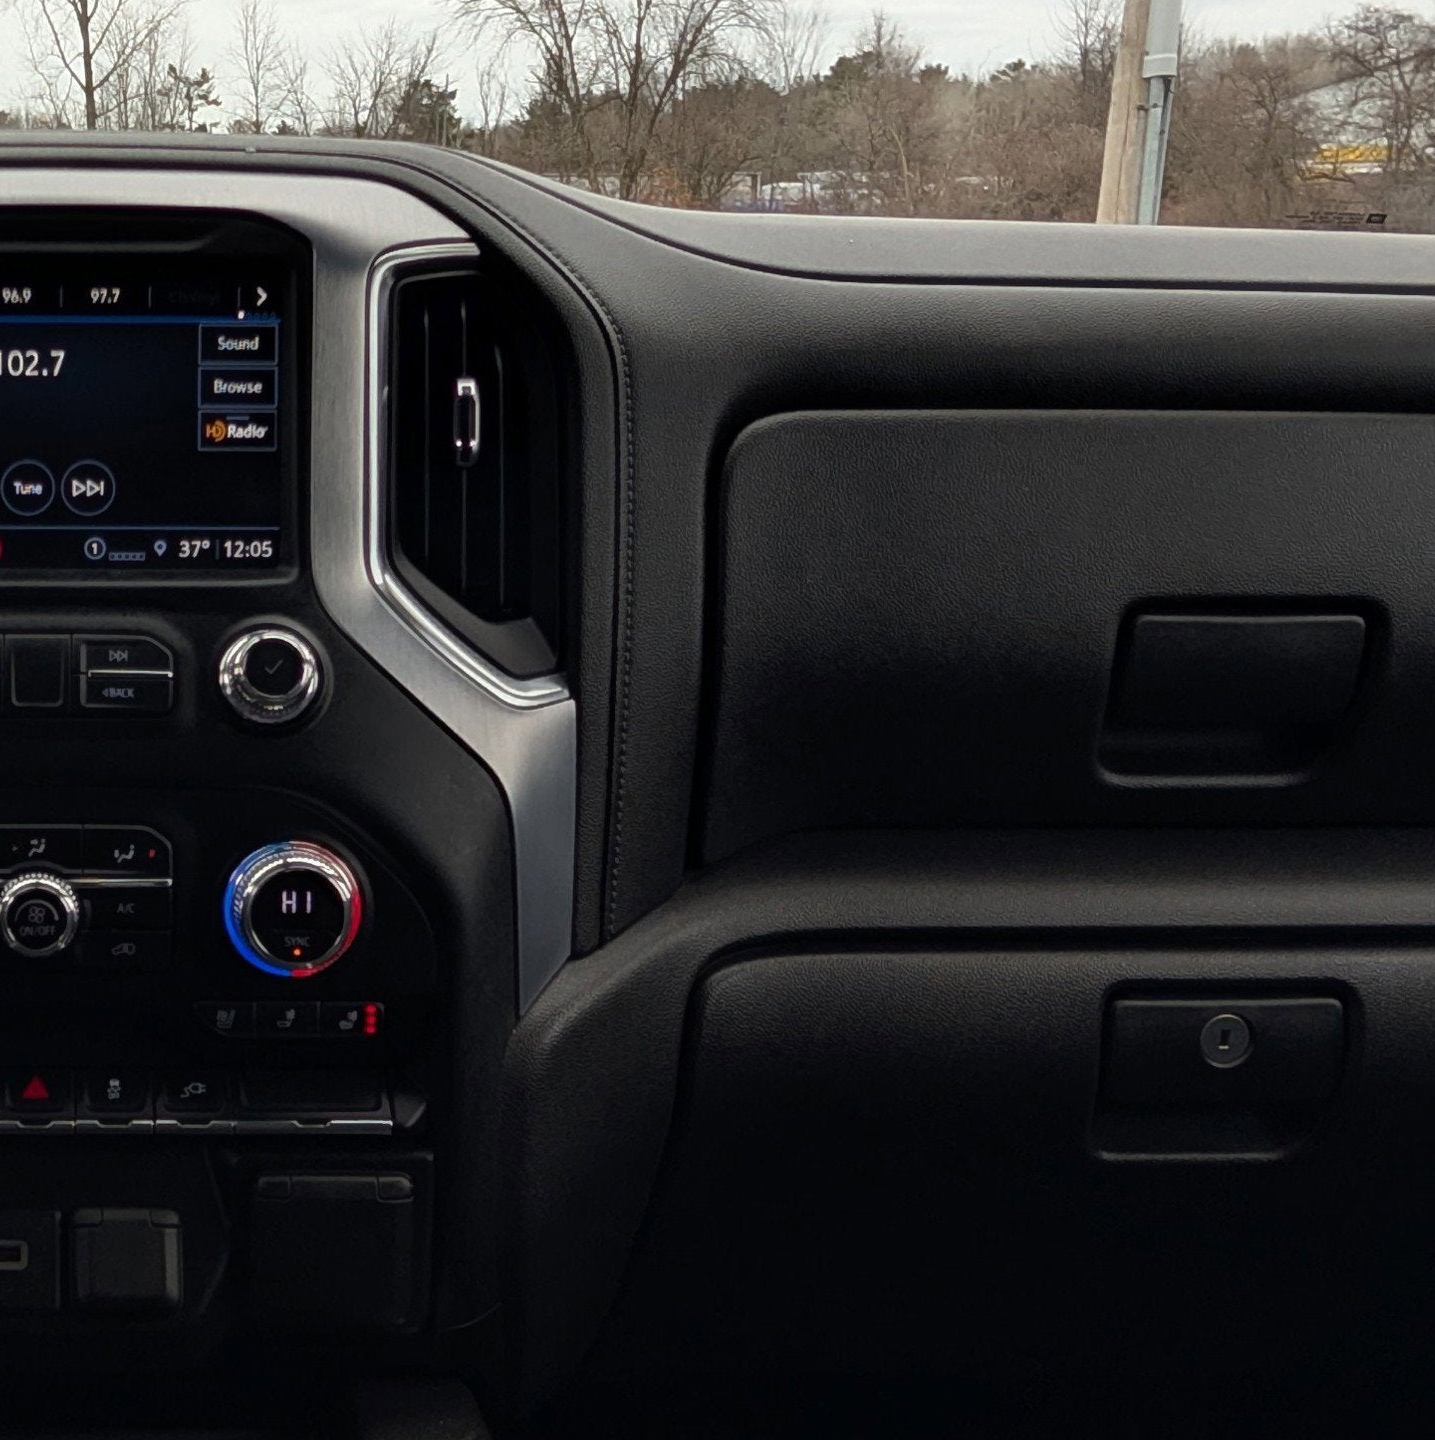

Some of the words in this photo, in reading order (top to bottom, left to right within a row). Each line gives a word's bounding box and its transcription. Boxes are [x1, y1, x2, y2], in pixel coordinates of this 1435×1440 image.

[1, 286, 33, 304] 96.9
[89, 286, 121, 304] 97.7
[217, 334, 261, 351] Sound
[213, 378, 263, 394] Browse
[13, 481, 43, 495] Tune
[178, 539, 211, 558] 37°
[223, 539, 274, 558] 12:05
[108, 687, 135, 699] BACK
[116, 902, 135, 915] A/C
[281, 890, 312, 914] HI
[19, 925, 57, 937] ON/OFF
[284, 936, 311, 948] SYNC
